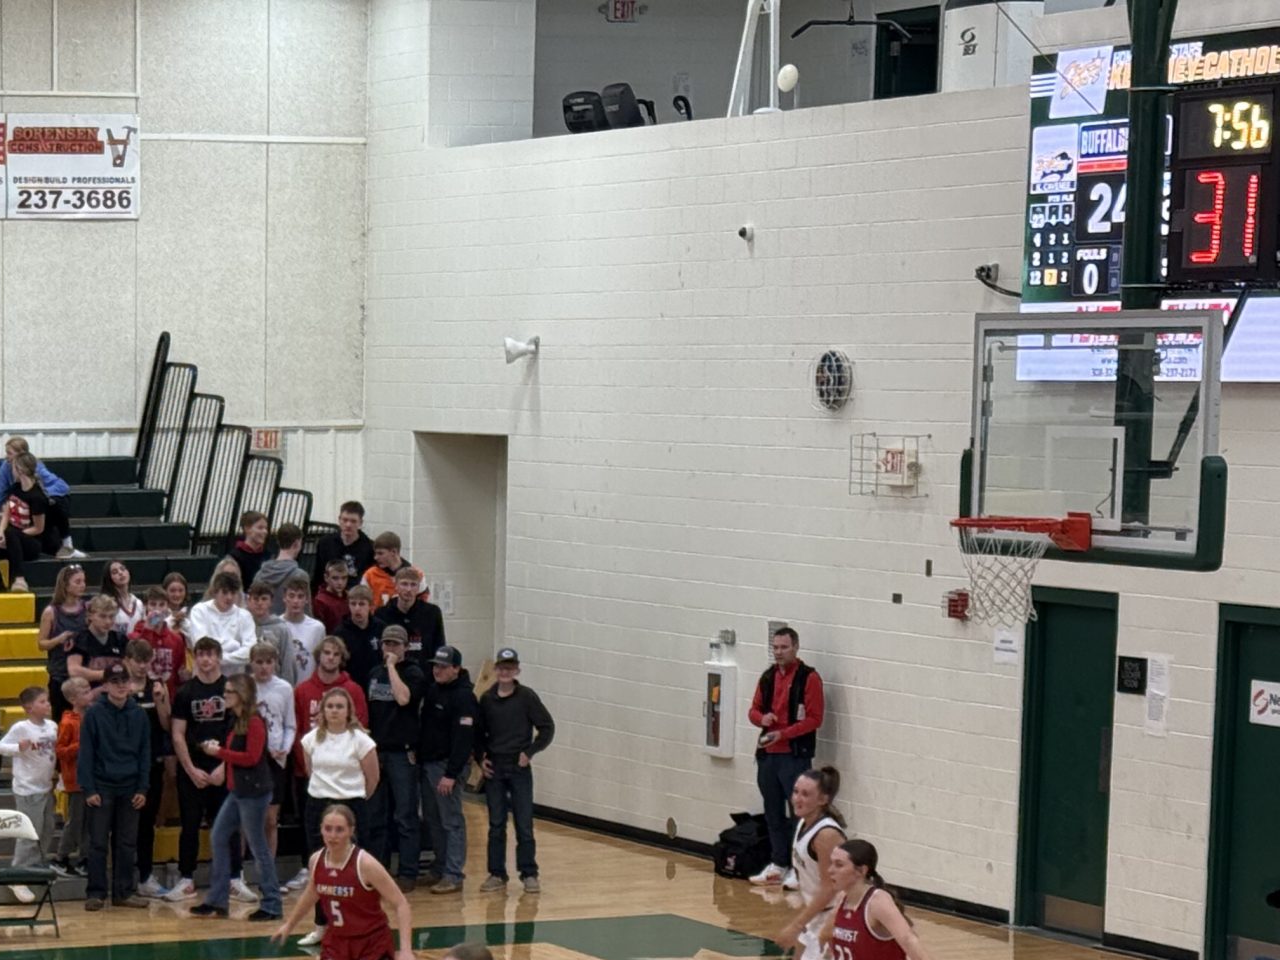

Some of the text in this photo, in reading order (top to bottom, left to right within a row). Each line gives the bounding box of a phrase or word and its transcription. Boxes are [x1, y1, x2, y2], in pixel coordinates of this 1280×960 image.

[14, 127, 99, 140] SORENSEN
[1208, 101, 1269, 150] 7:56
[1081, 127, 1128, 155] BUFFALO
[71, 176, 136, 184] PROFESSIONALS
[17, 189, 132, 210] 237-3686
[329, 900, 344, 927] 5
